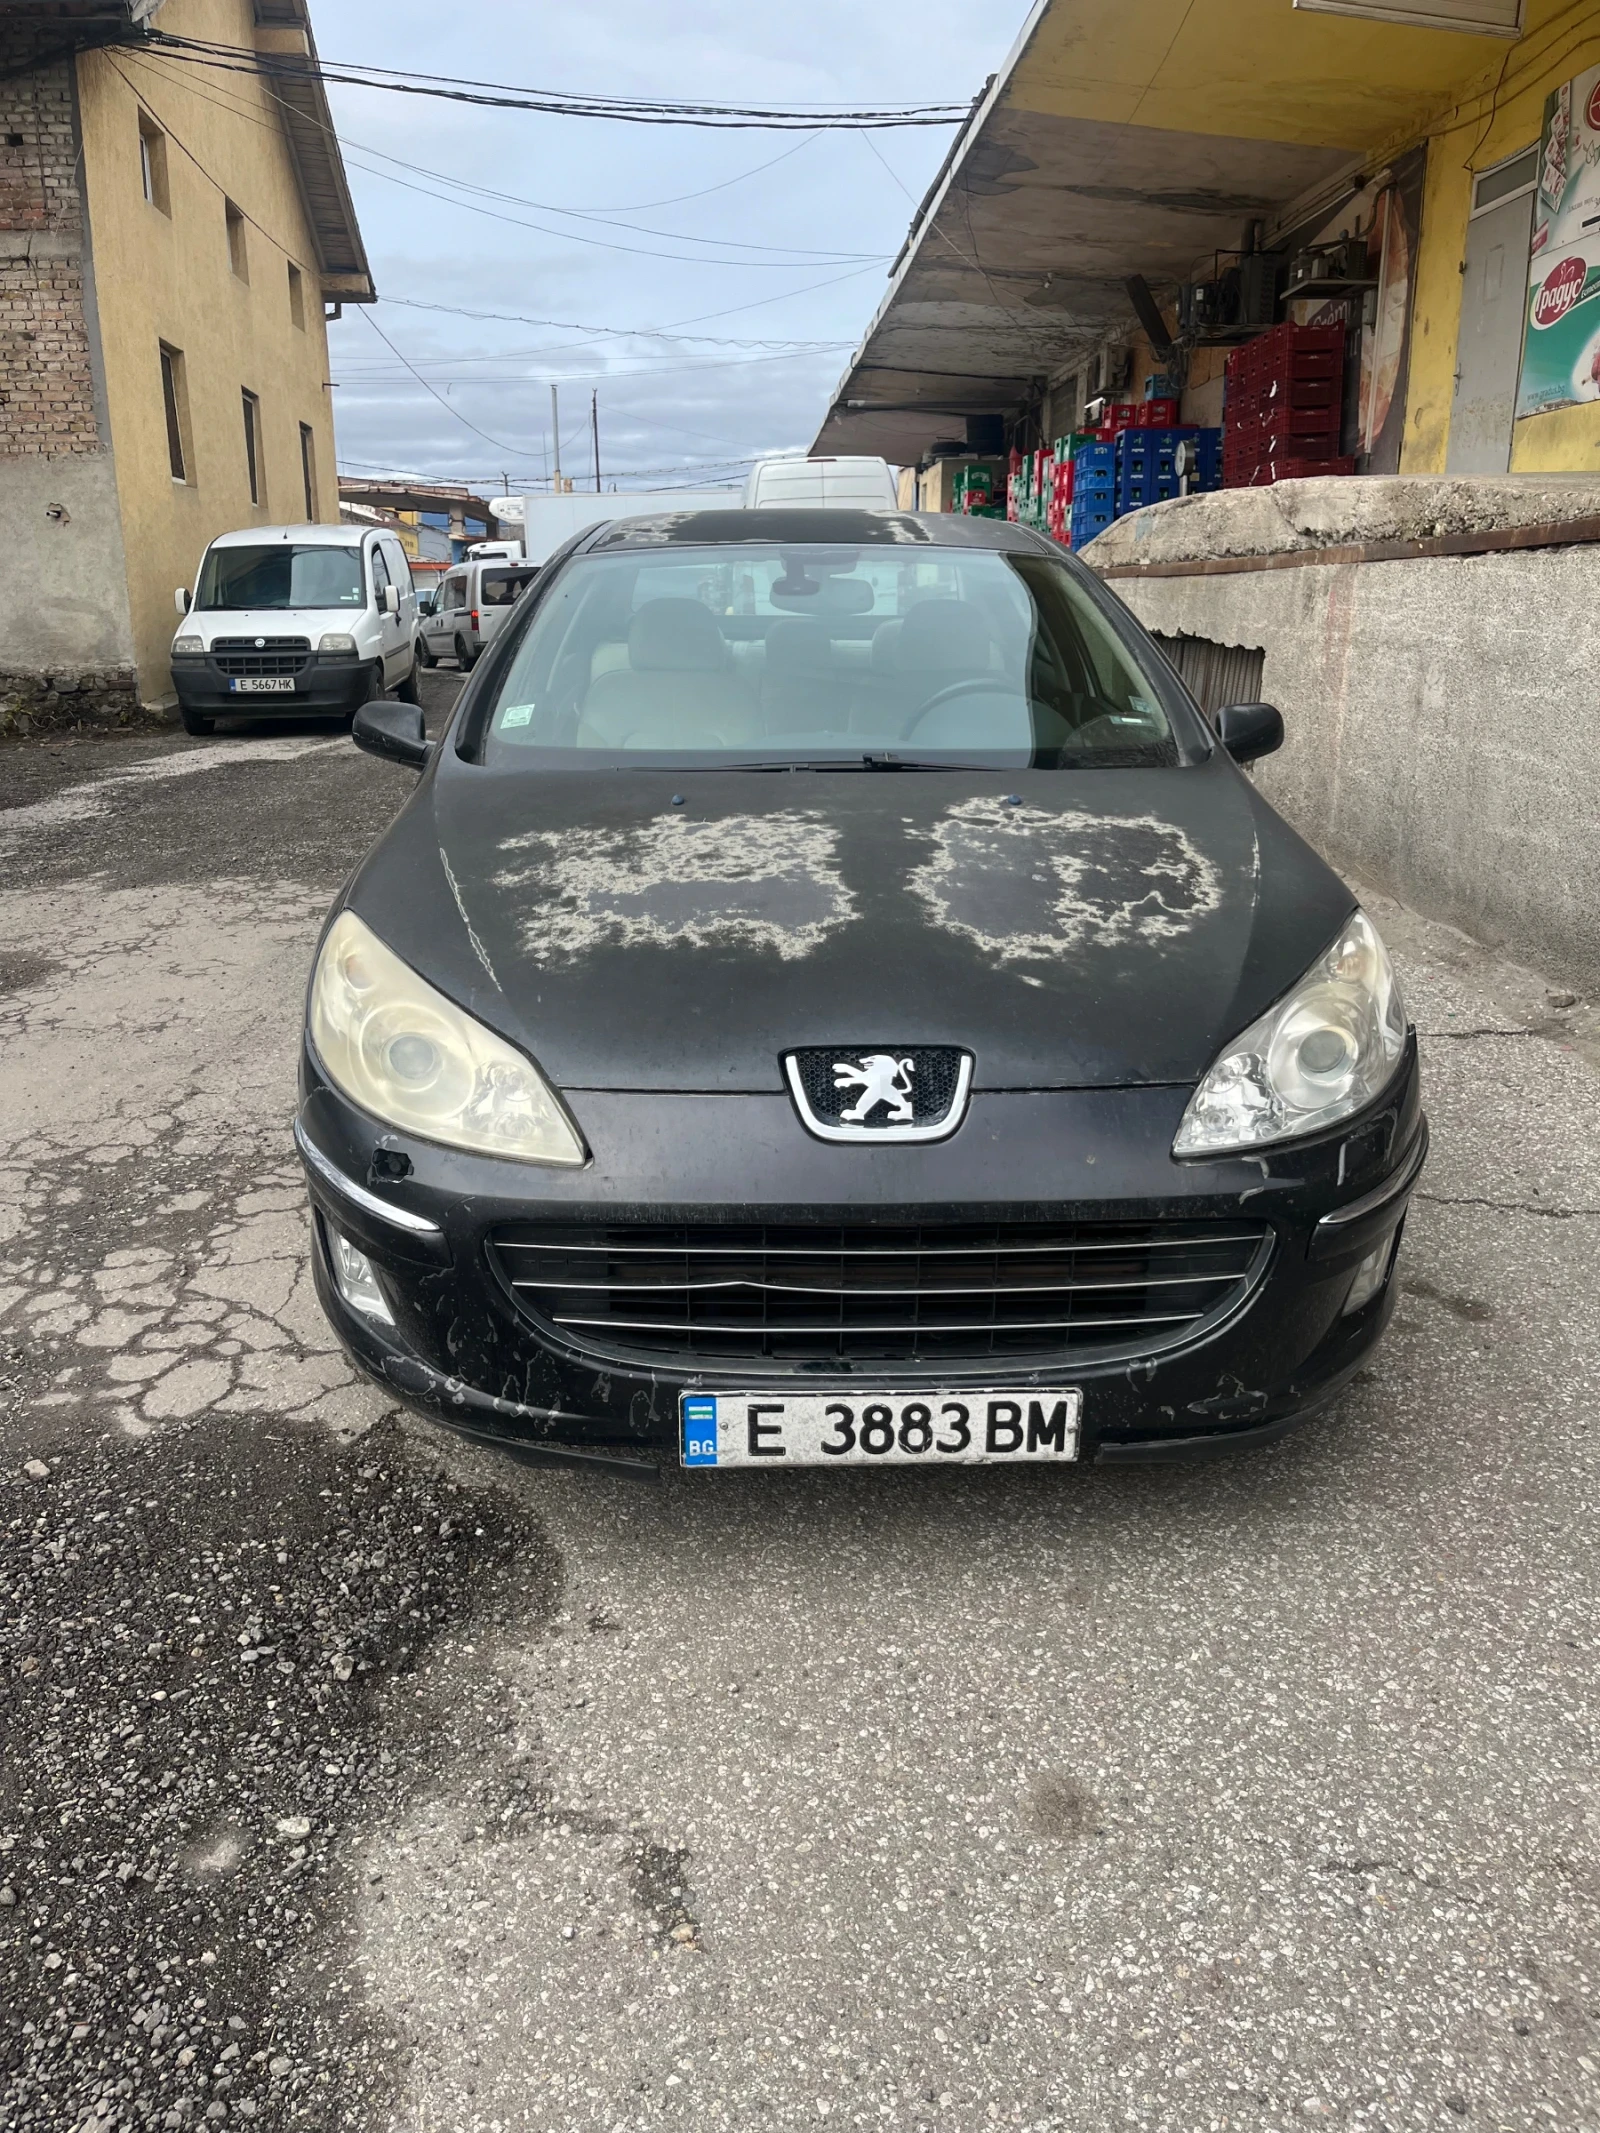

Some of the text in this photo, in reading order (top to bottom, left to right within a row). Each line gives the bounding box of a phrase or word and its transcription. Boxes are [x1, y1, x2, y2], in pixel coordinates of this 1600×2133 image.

[1535, 278, 1582, 319] Градус
[240, 679, 248, 690] E
[252, 679, 277, 690] 5667
[278, 679, 292, 690] HK
[747, 1399, 1069, 1457] E 3883 BM
[689, 1439, 715, 1457] BG
